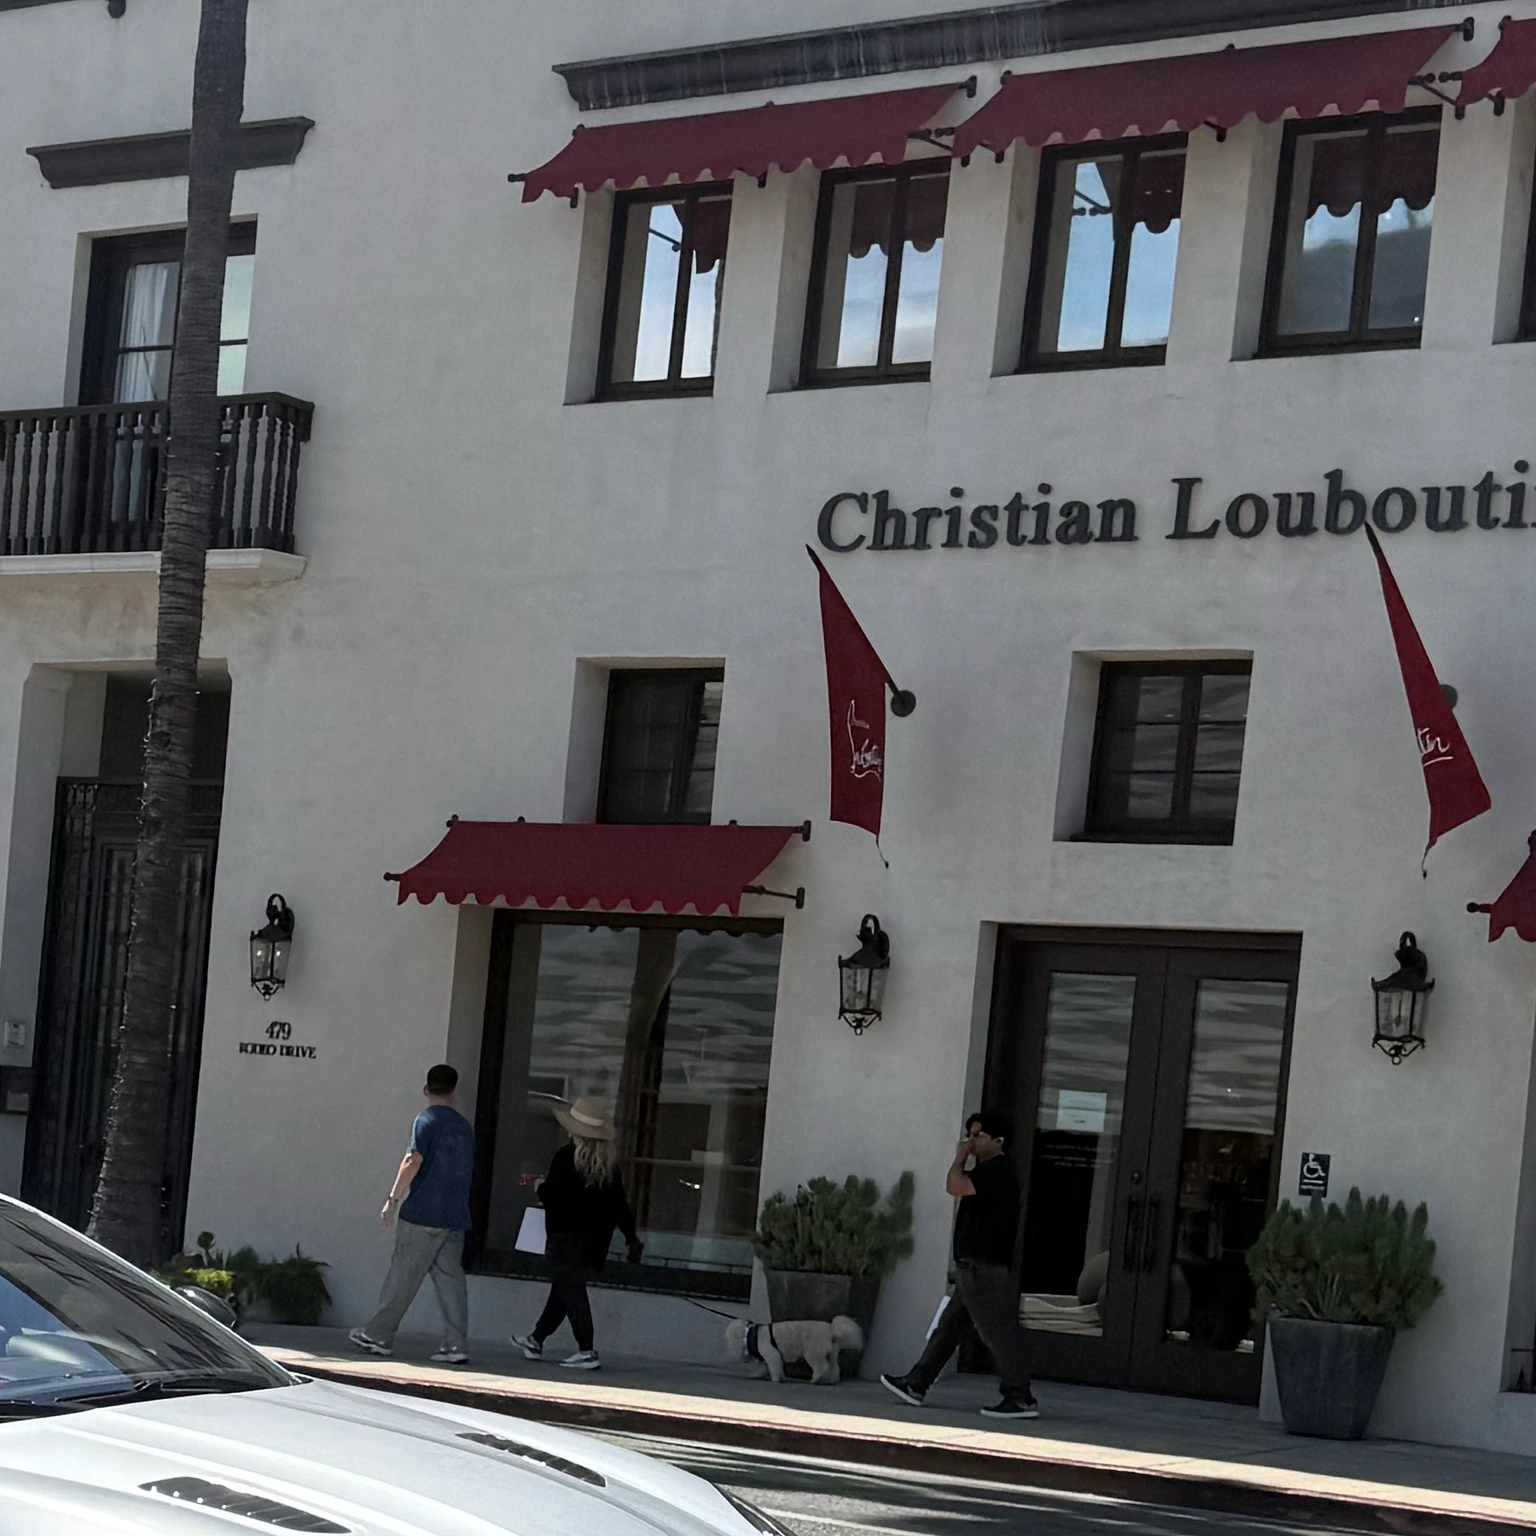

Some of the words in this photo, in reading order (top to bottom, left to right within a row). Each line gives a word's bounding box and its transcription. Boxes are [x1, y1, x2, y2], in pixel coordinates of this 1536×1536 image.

[817, 482, 1139, 552] Christian
[1165, 459, 1536, 539] Loubouti
[265, 1020, 292, 1041] 479
